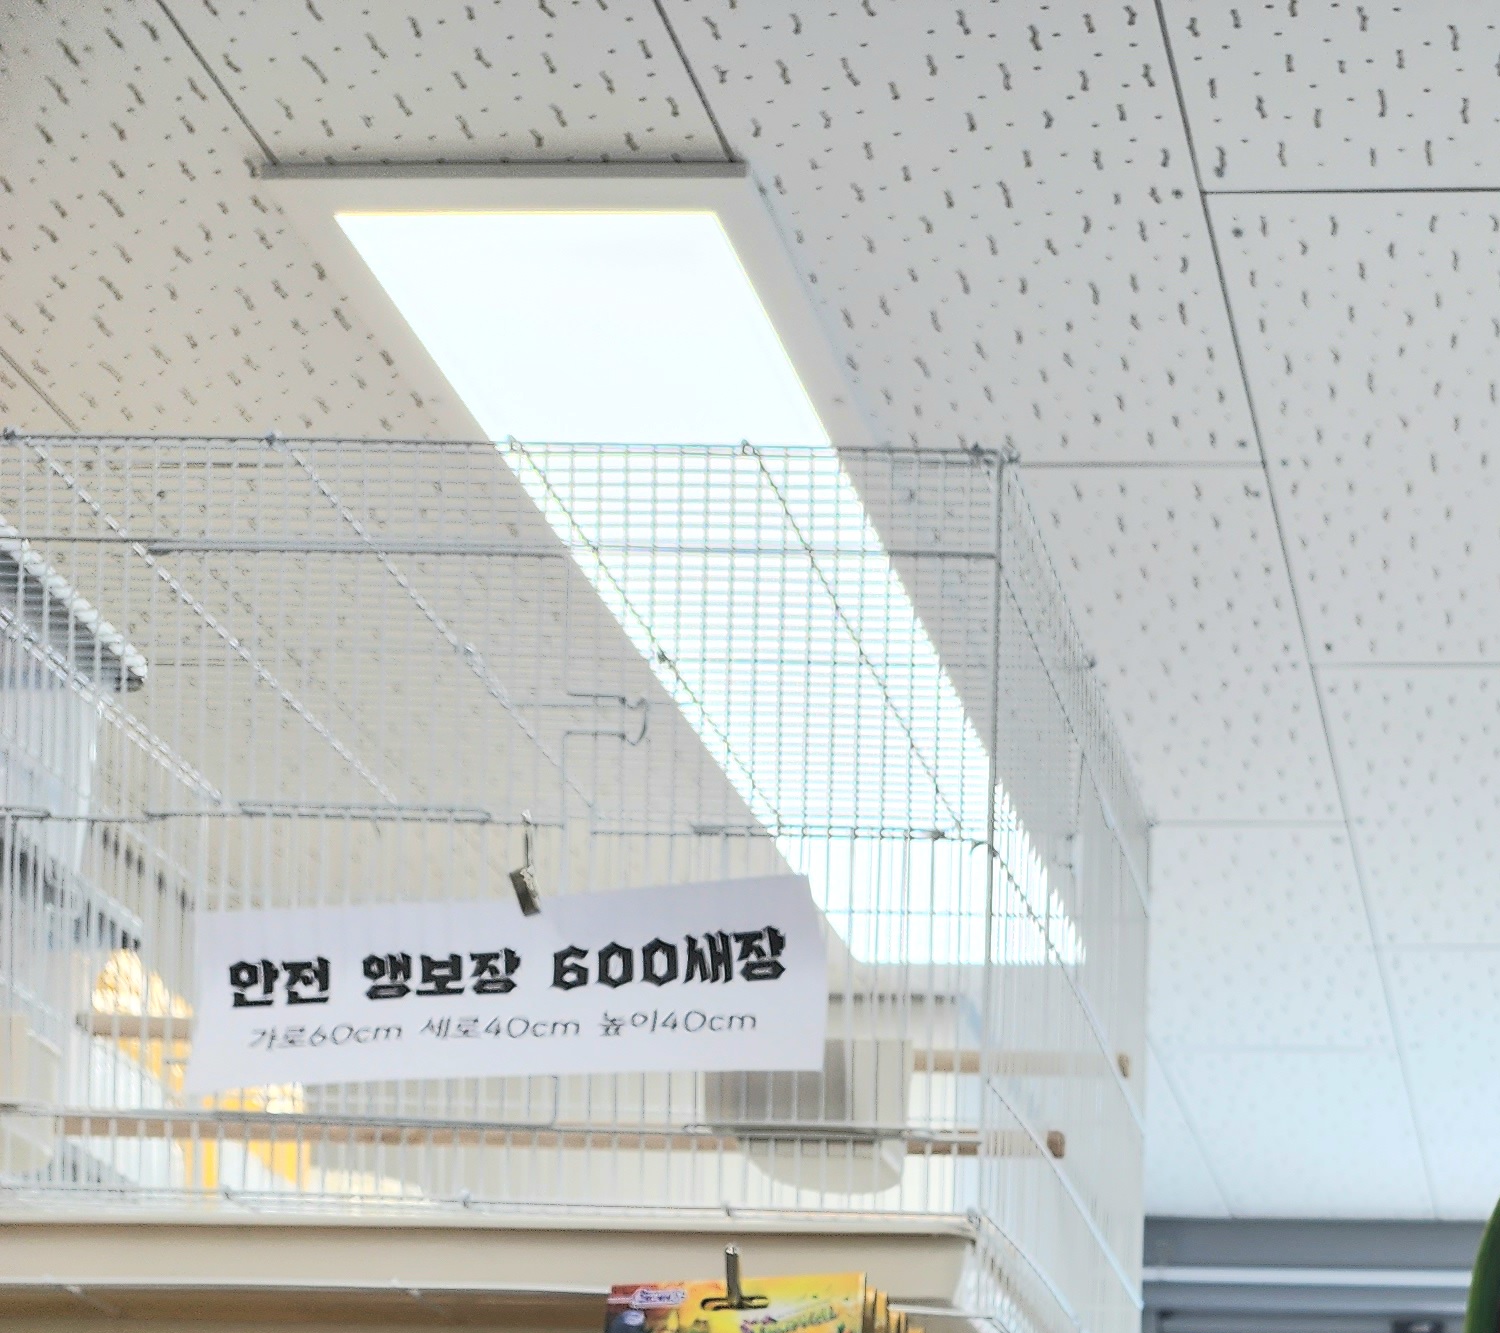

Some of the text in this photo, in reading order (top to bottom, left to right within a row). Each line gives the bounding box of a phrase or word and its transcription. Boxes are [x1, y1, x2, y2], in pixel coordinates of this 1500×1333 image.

[229, 956, 331, 1007] 안전
[551, 926, 786, 990] 600새장
[250, 1008, 757, 1050] 가로60cm 세로40cm 높이40cm
